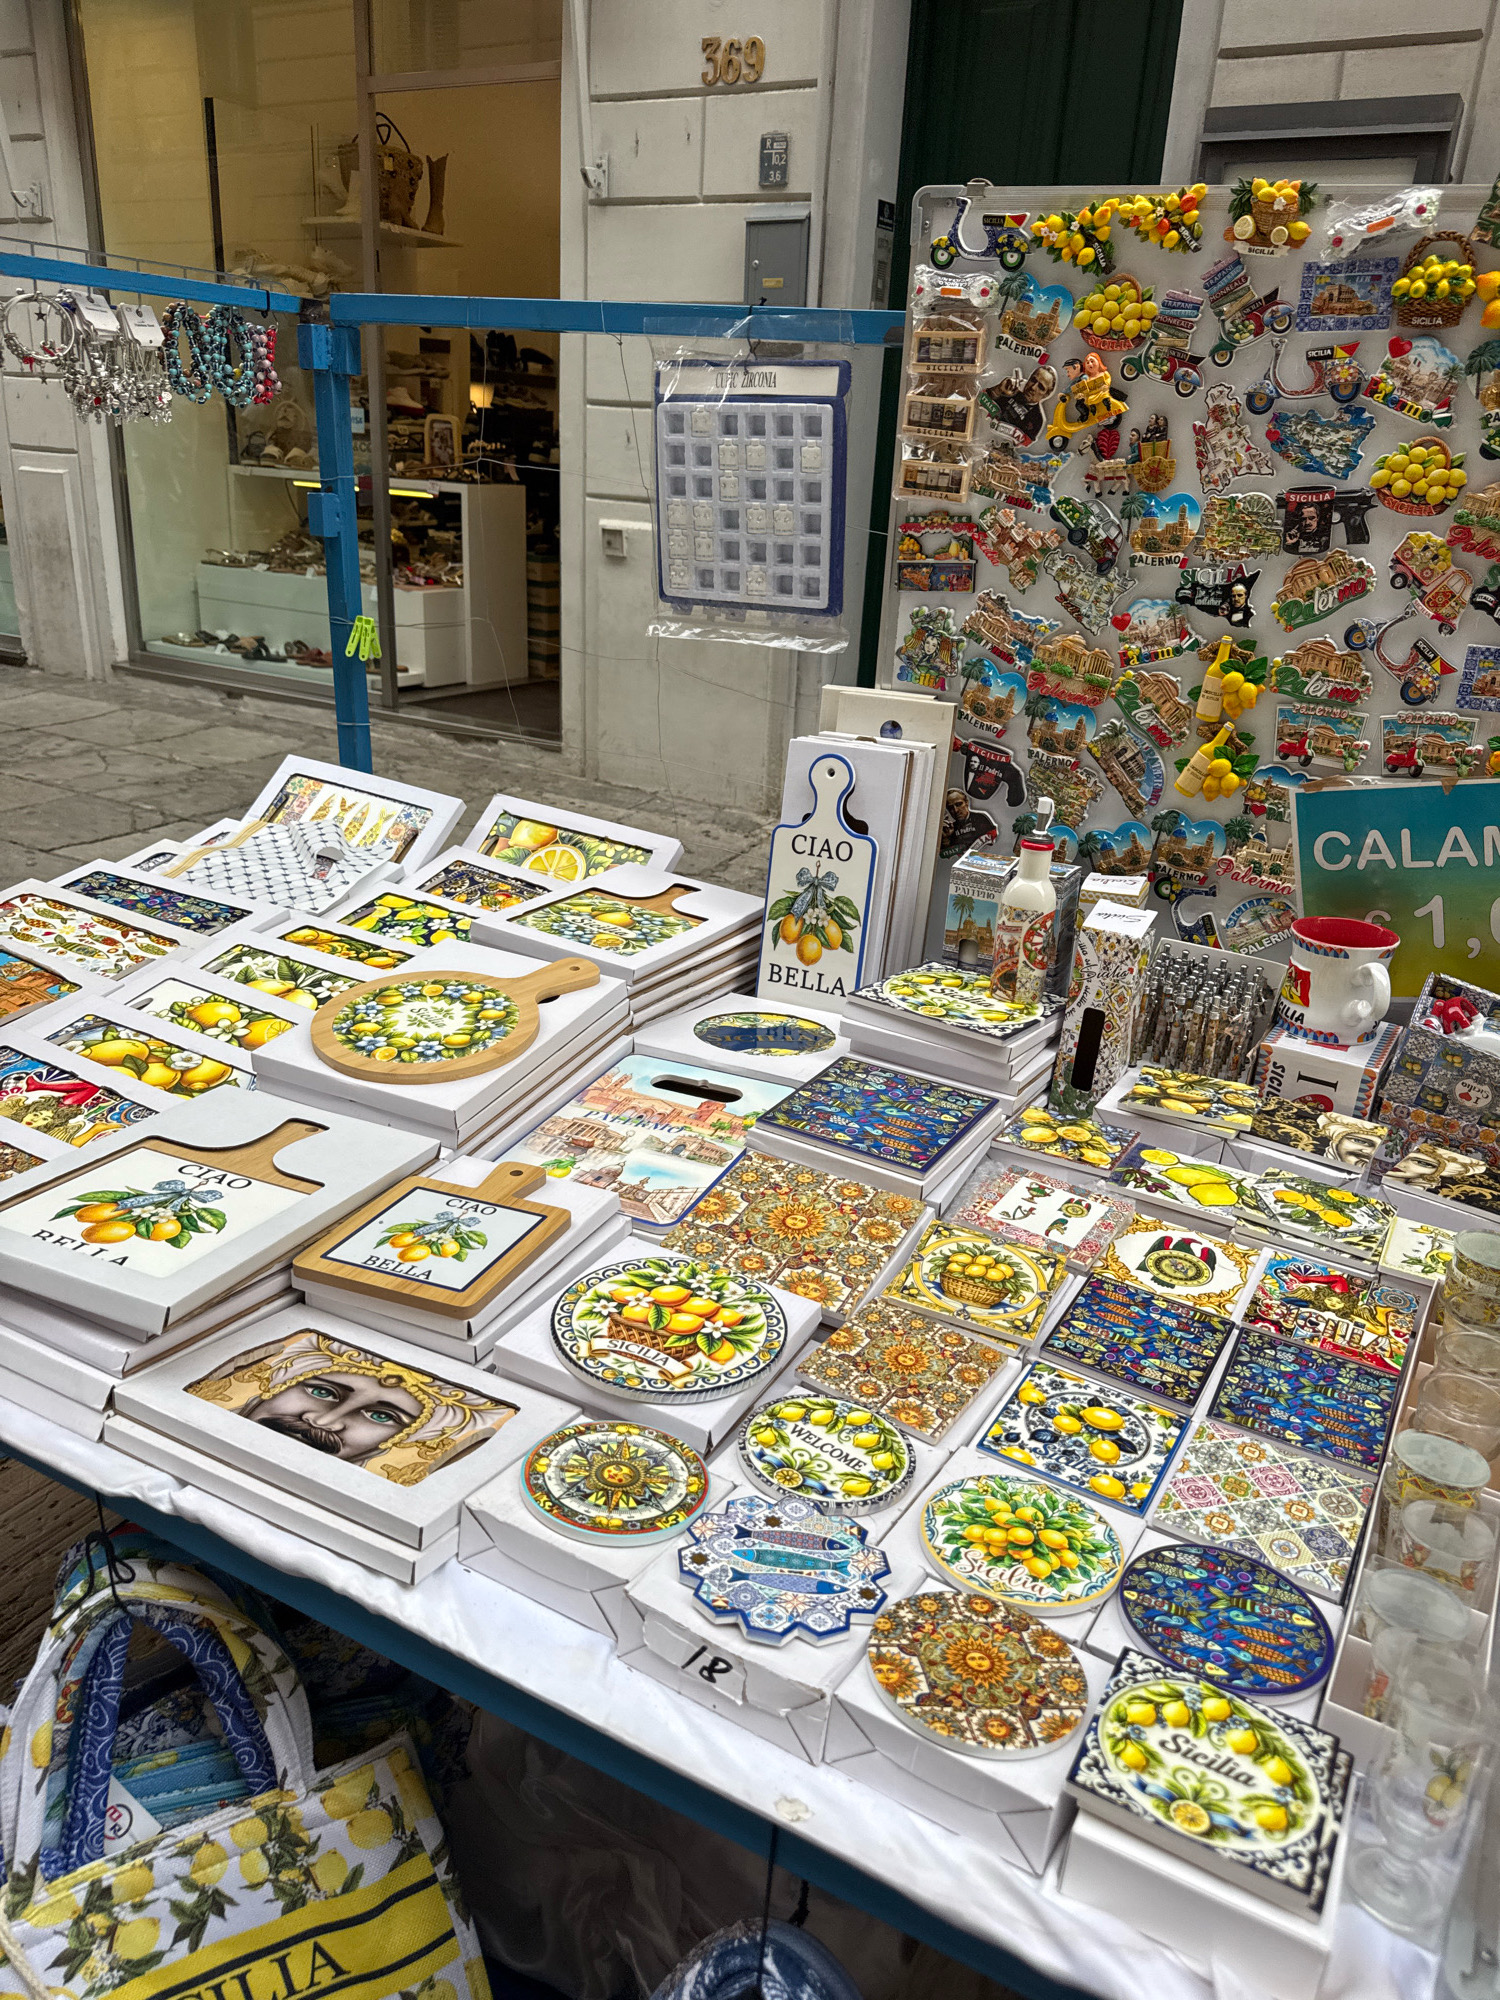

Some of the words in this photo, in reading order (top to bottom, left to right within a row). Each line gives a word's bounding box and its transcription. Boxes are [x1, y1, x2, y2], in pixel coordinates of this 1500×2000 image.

[701, 36, 766, 87] 369
[766, 139, 772, 149] R
[1092, 242, 1107, 268] SICILIA
[1247, 247, 1275, 256] SICILIA
[1204, 265, 1234, 289] TRAPANI
[1209, 275, 1248, 302] MONREALE
[1162, 300, 1194, 309] TRAPANI
[1156, 315, 1194, 330] MONREALE
[1411, 316, 1443, 325] SICILIA
[997, 335, 1042, 358] PALERMO
[1088, 336, 1134, 350] SICILIA
[1307, 349, 1332, 359] SICILIA
[926, 364, 965, 372] SICILIA
[741, 372, 777, 388] ZIRCONIA
[981, 394, 997, 413] ITALY
[916, 428, 955, 437] SICILIA
[912, 489, 949, 500] SICILIA
[1289, 493, 1332, 502] SICILIA
[1385, 497, 1435, 516] SICILIA
[1132, 555, 1180, 567] PALERMO
[1180, 563, 1247, 588] SICILIA
[1413, 598, 1433, 618] SICILIA
[1415, 639, 1435, 660] SICILIA
[1027, 671, 1104, 708] Palermo
[959, 710, 999, 734] PALERMO
[970, 745, 1007, 762] SICILIA
[1031, 750, 1073, 768] PALERMO
[791, 834, 854, 862] CIAO
[942, 847, 960, 857] ITALY
[1089, 876, 1141, 886] Sicilia
[1156, 863, 1201, 882] PALERMO
[1215, 856, 1295, 896] Palermo
[1094, 911, 1149, 924] Sicilia
[1226, 899, 1267, 929] SICILIA
[572, 917, 631, 936] Sicilia
[768, 962, 847, 998] BELLA
[1080, 963, 1129, 984] Sicilia
[929, 987, 995, 1008] Sicilia
[410, 1007, 447, 1029] Sicilia
[583, 1110, 685, 1134] PALERMO
[178, 1164, 253, 1190] CIAO
[445, 1198, 498, 1216] CIAO
[361, 1254, 433, 1281] BELLA
[1256, 1298, 1395, 1359] SICILIA
[606, 1338, 671, 1367] SICILIA
[790, 1423, 868, 1473] WELCOME
[1032, 1442, 1101, 1477] Sicilia
[954, 1547, 1053, 1598] Sicilia
[681, 1645, 734, 1684] 18
[1158, 1732, 1260, 1790] Sicilia
